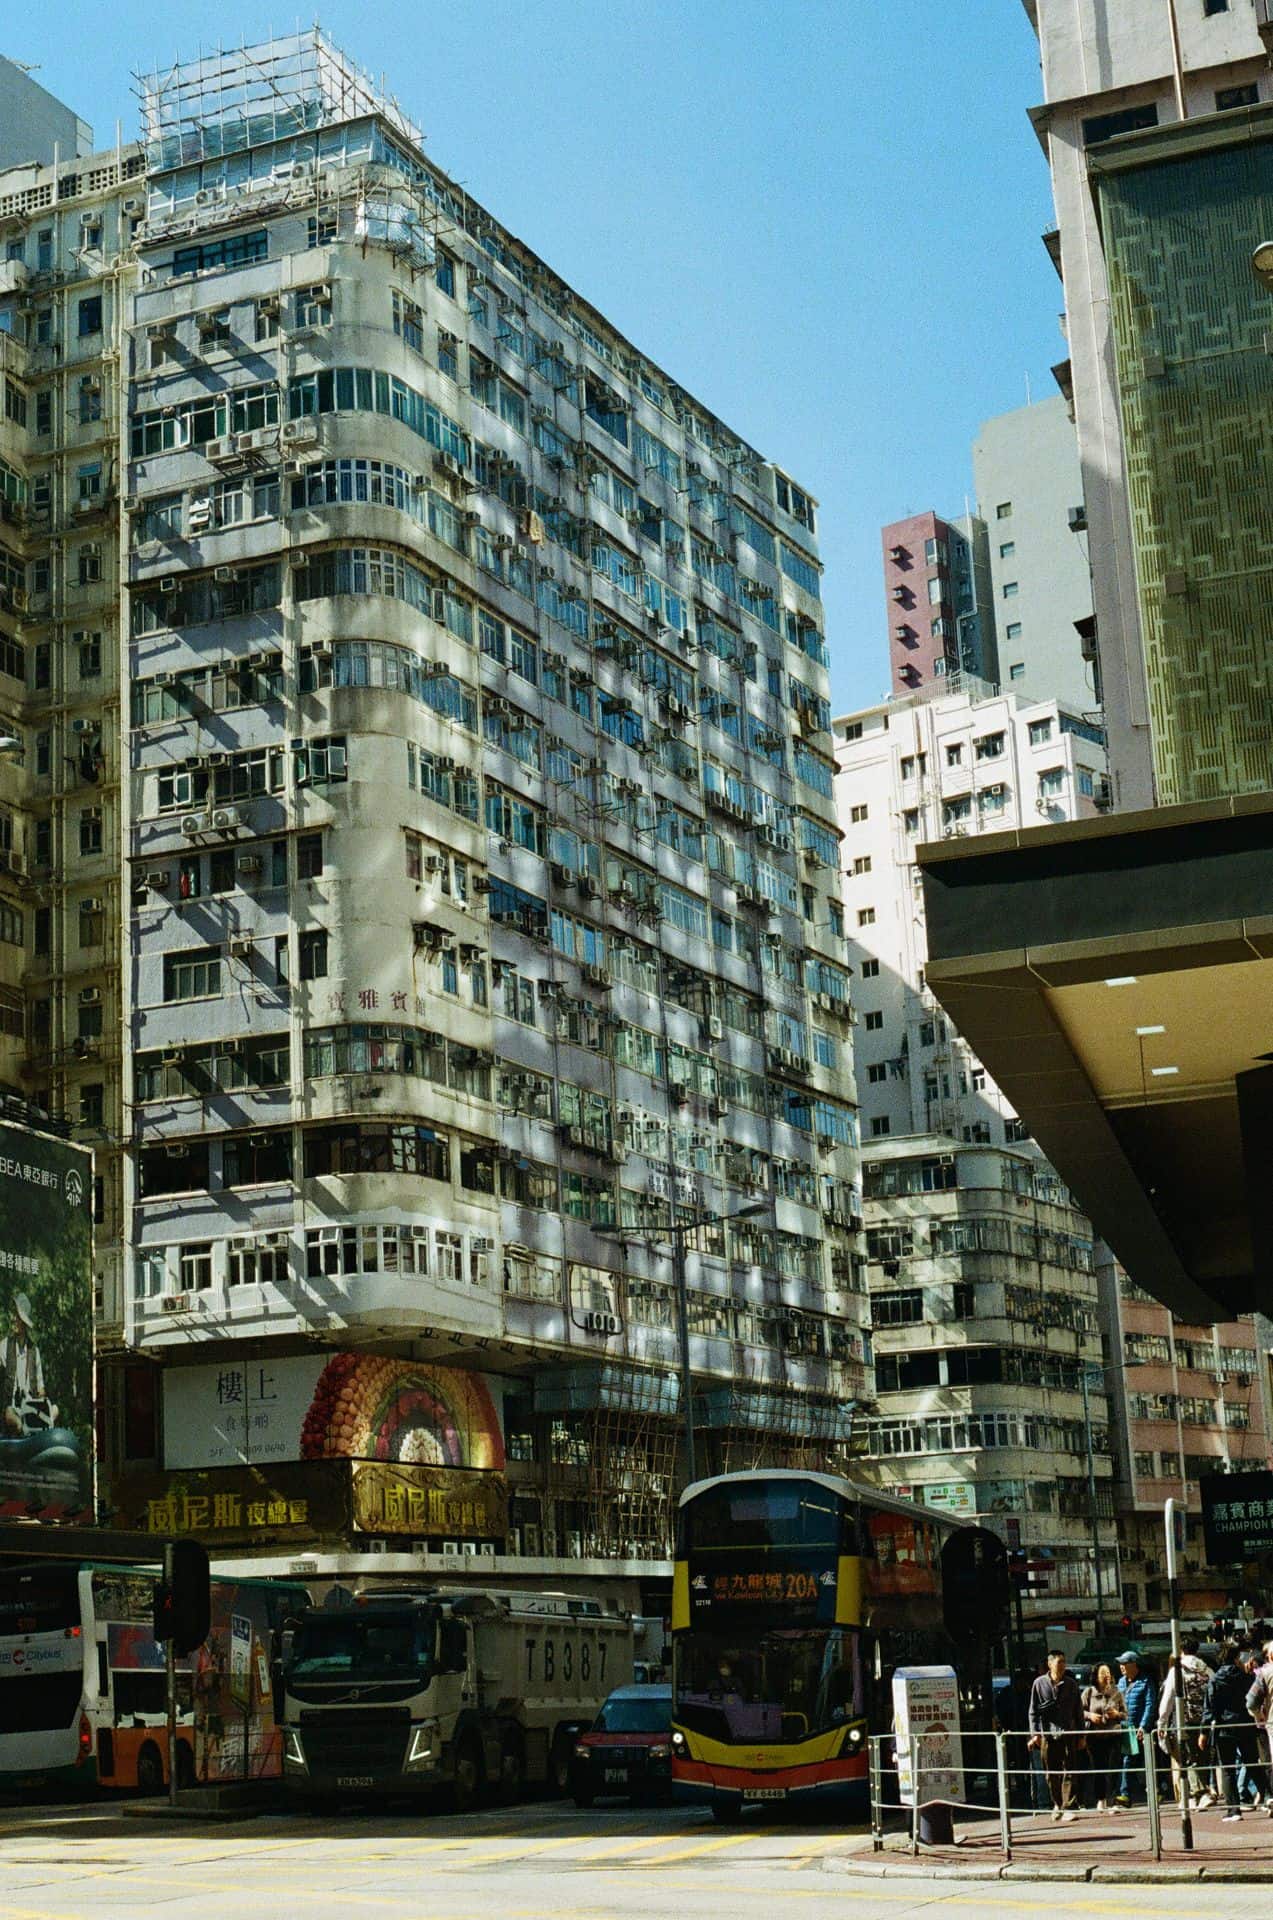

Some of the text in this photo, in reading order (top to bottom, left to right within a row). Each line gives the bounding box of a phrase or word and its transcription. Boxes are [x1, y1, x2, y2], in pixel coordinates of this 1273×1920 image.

[0, 1157, 22, 1178] BEA
[23, 1164, 58, 1189] 東亞銀行
[216, 1368, 277, 1404] 樓上
[1215, 1519, 1268, 1535] CHAMPION
[786, 1573, 818, 1598] 20A
[525, 1638, 607, 1683] TB387
